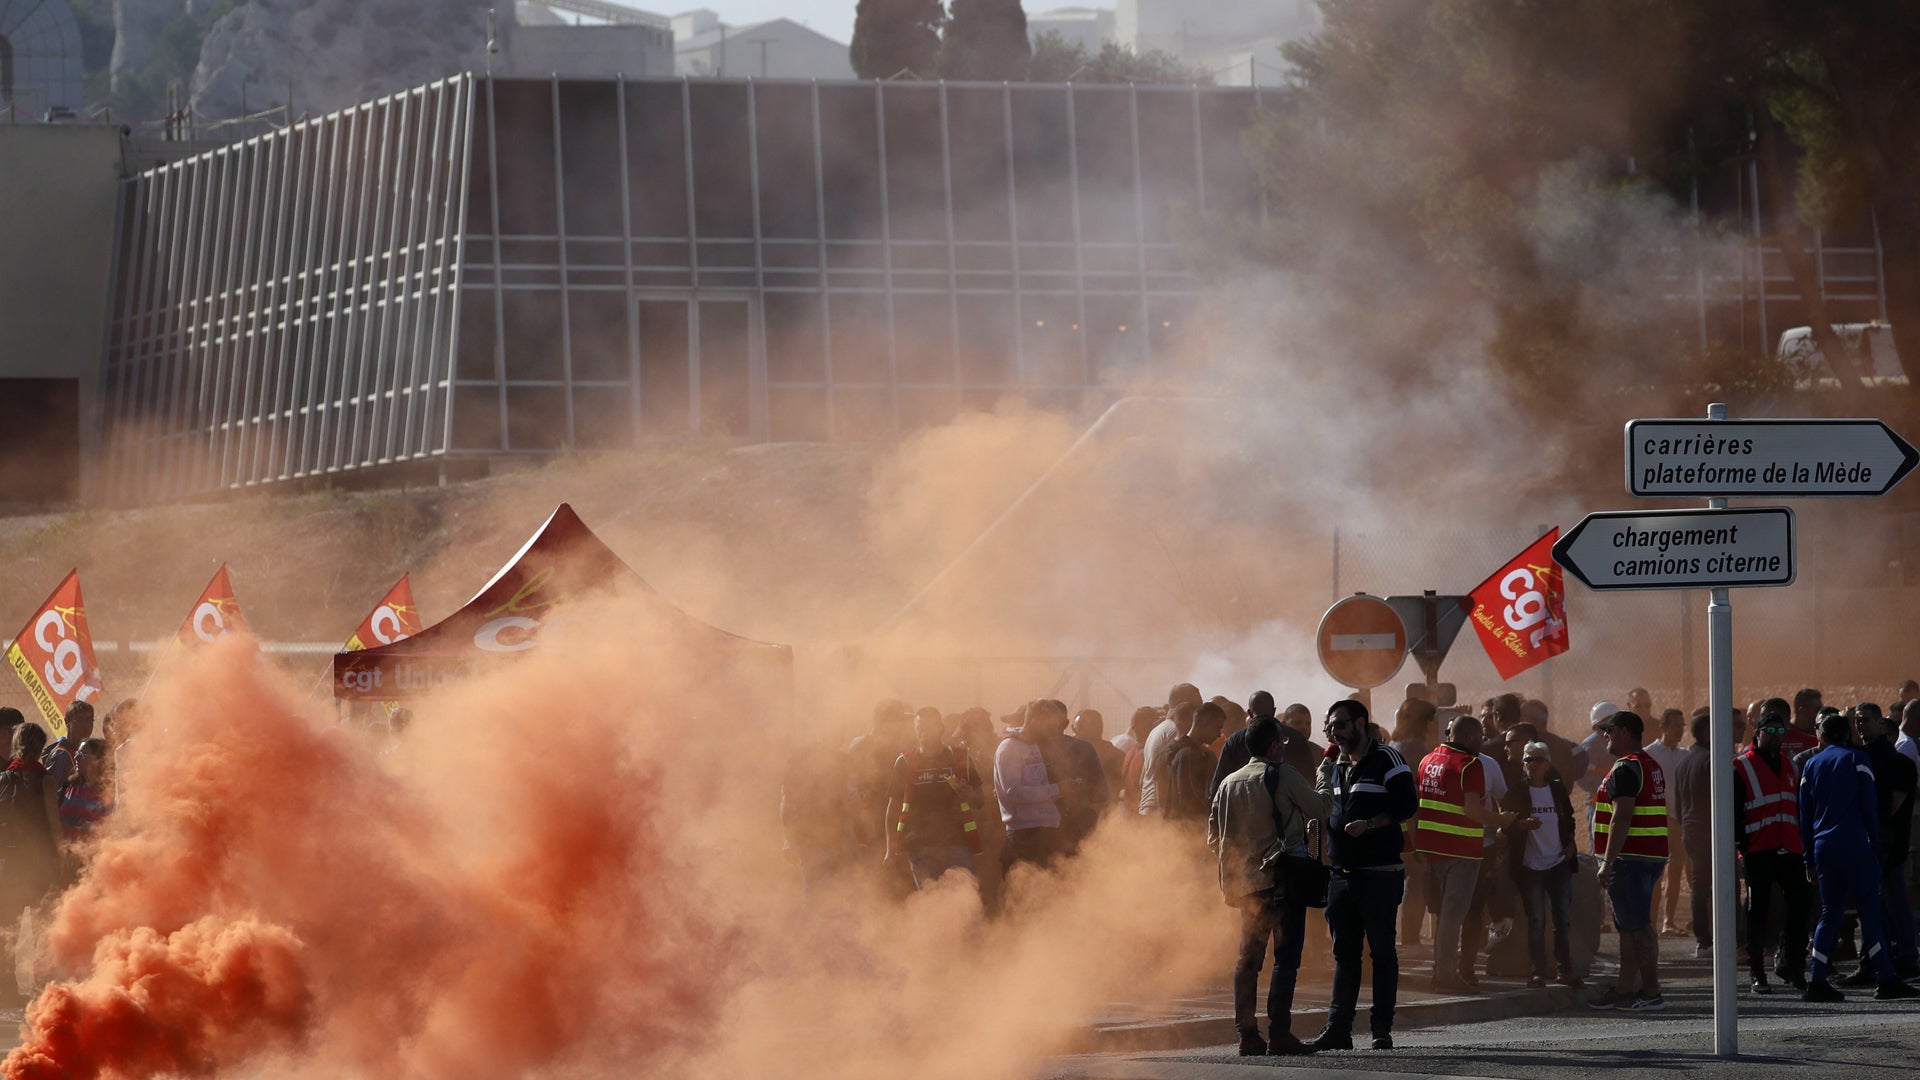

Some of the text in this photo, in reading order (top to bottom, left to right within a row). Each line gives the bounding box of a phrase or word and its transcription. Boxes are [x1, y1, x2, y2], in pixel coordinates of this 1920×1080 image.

[1643, 433, 1753, 455] carrières
[1643, 461, 1872, 489] plateforme de la Mède
[1612, 524, 1738, 552] chargement
[1612, 551, 1780, 577] camions citerne
[1500, 567, 1566, 649] cgt
[342, 664, 383, 693] cgt
[23, 670, 63, 731] MARTIGUES
[1425, 763, 1444, 778] cgt
